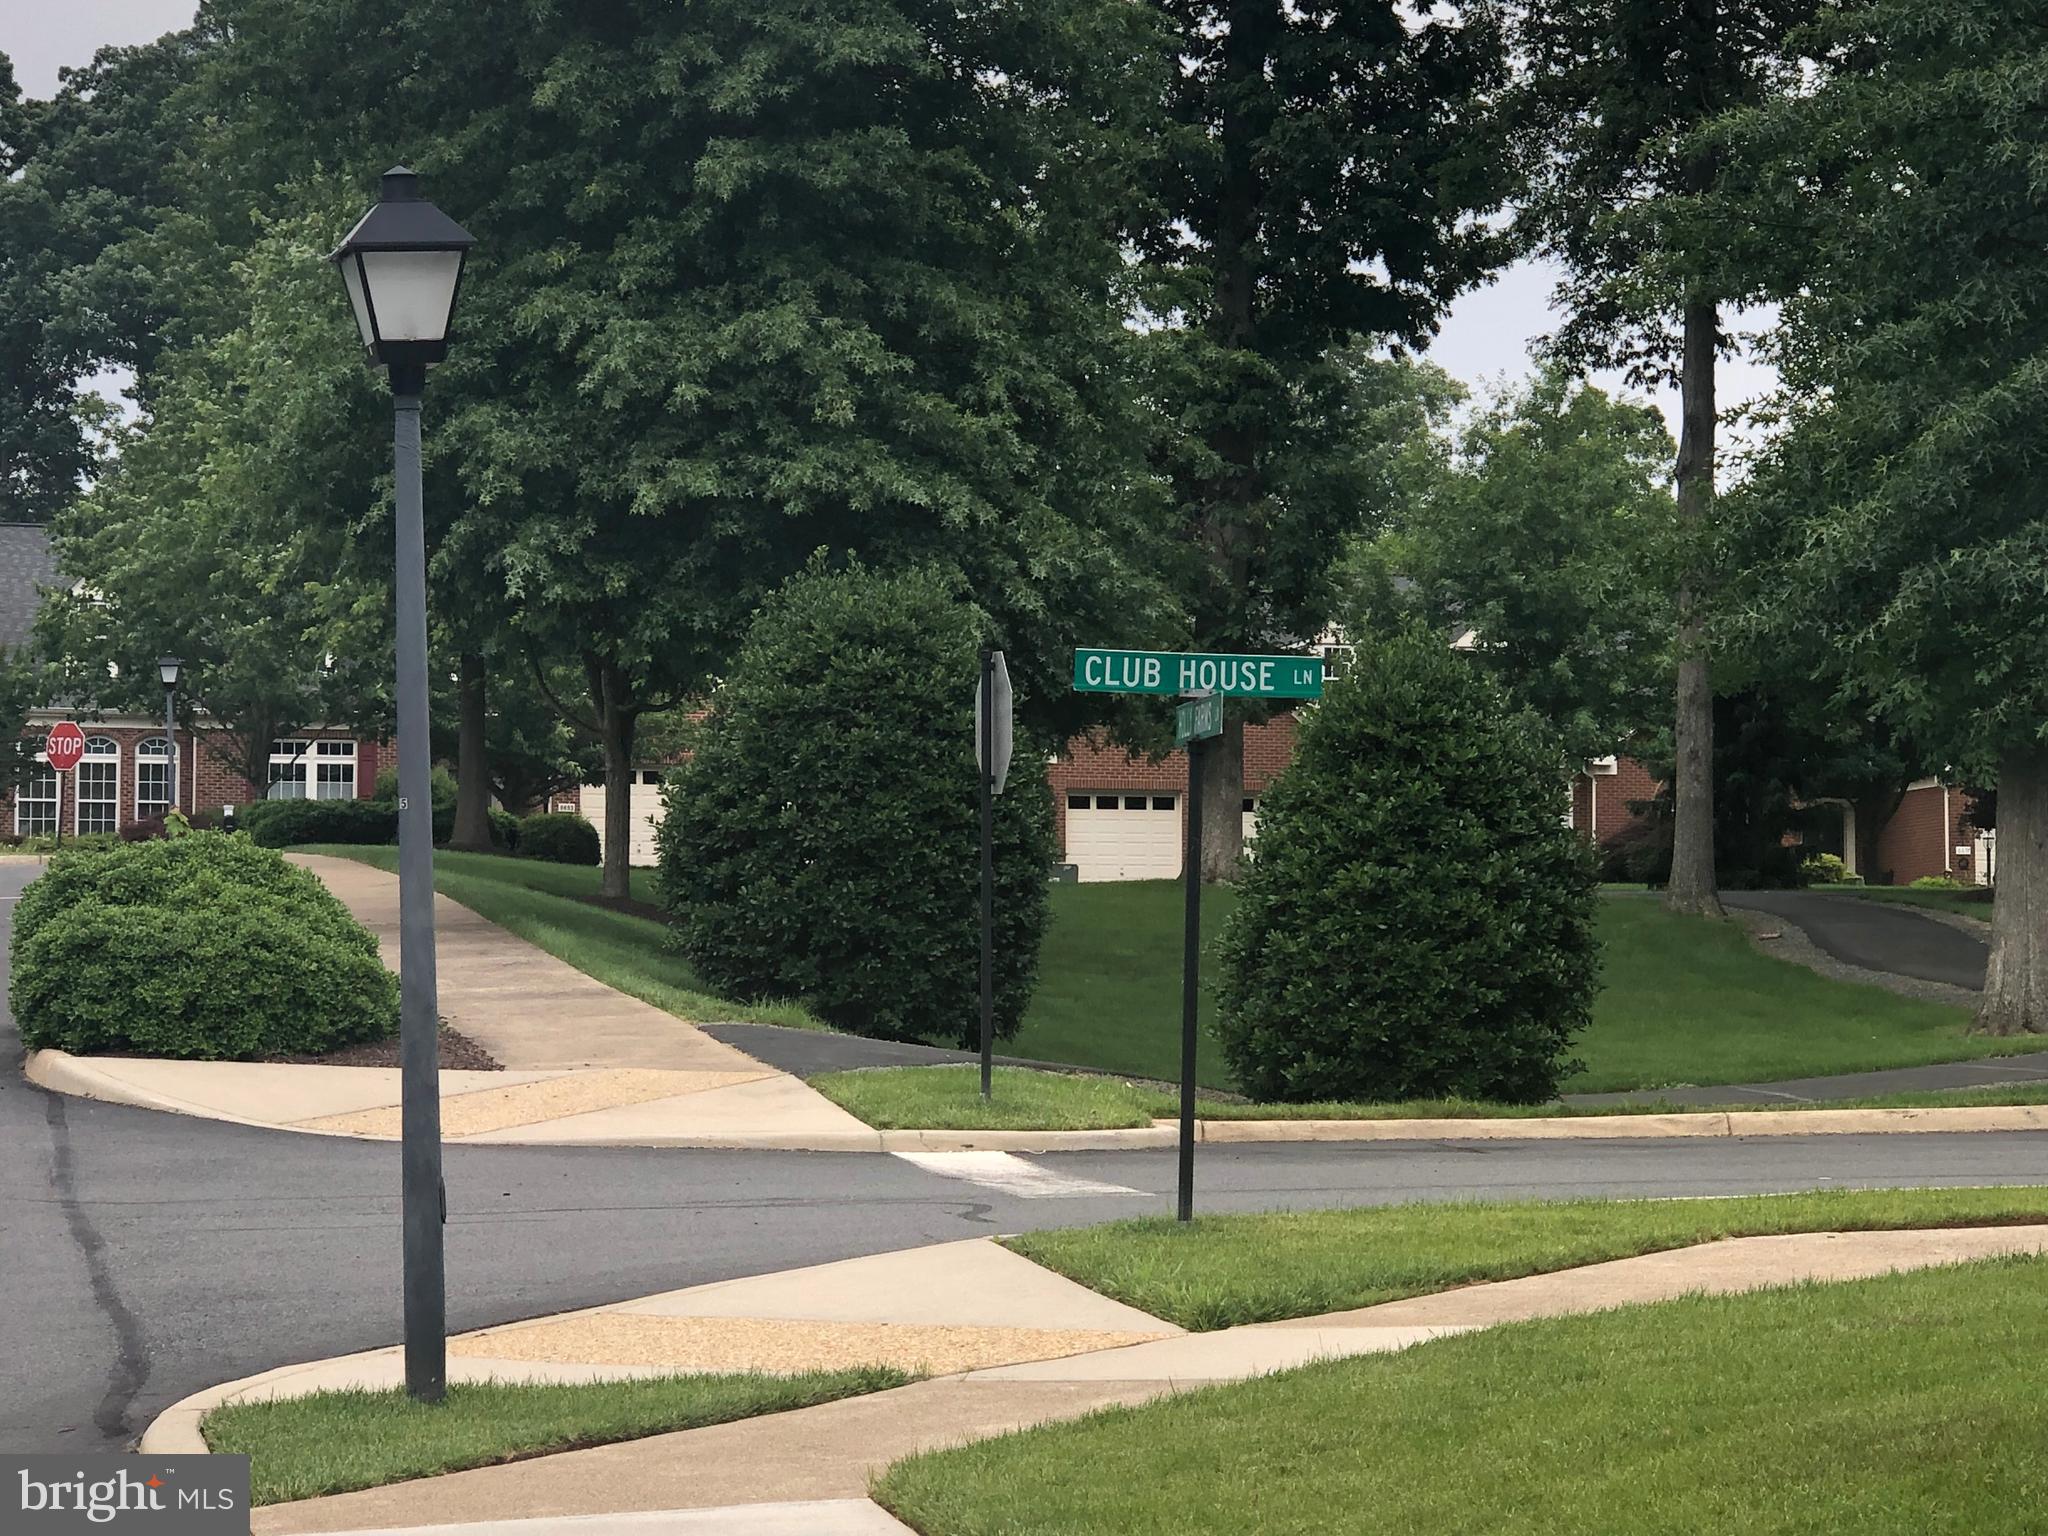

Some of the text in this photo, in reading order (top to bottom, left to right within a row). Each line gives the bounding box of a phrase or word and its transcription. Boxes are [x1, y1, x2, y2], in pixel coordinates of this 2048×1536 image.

[1085, 655, 1313, 691] CLUB HOUSE LN
[48, 737, 82, 755] STOP
